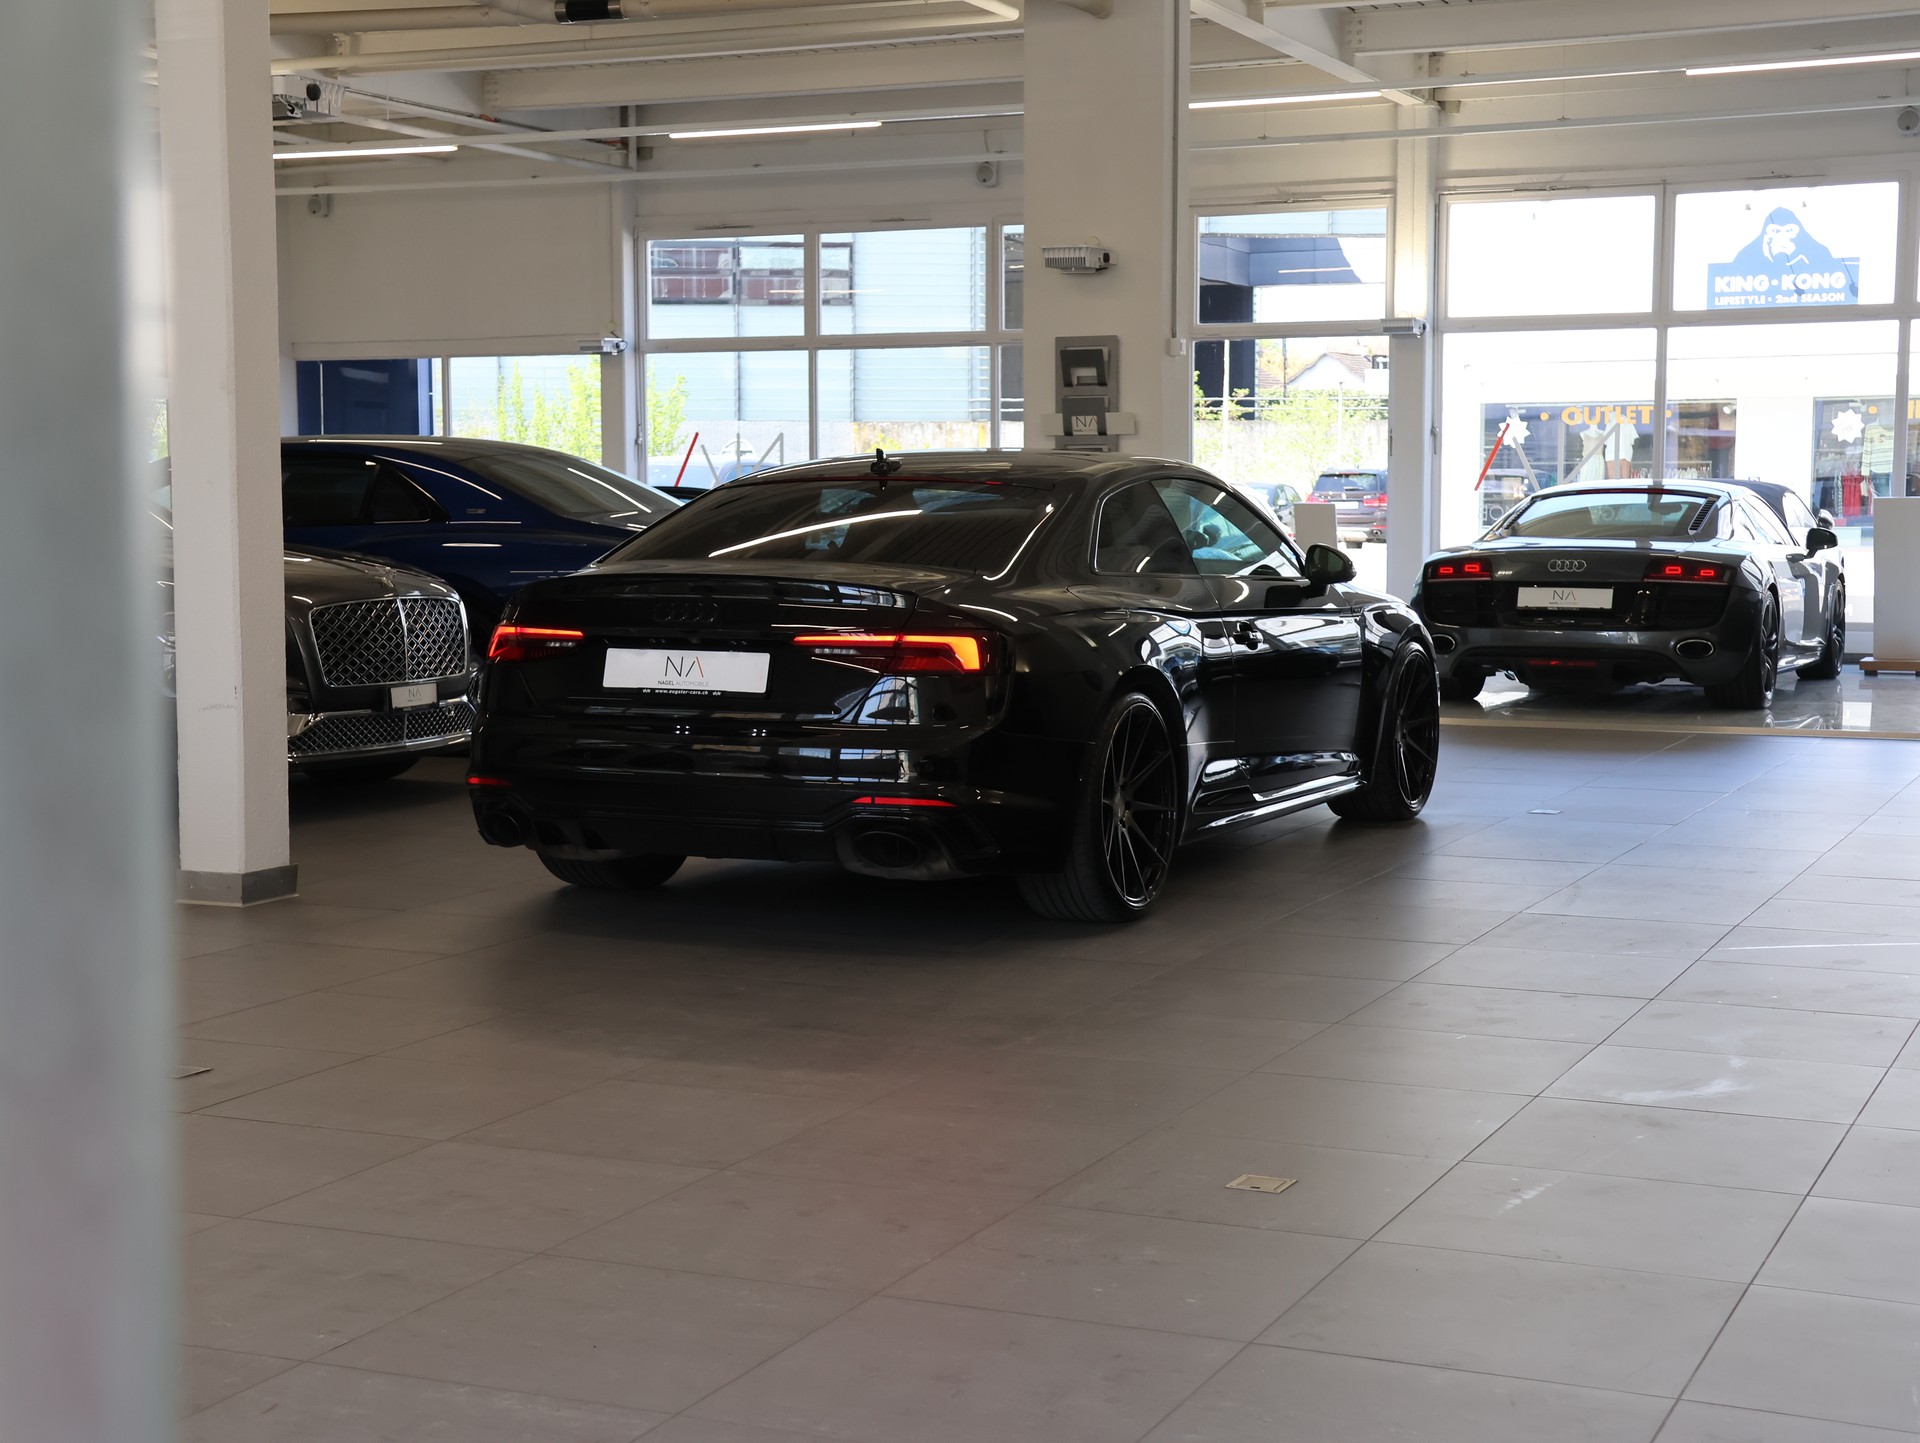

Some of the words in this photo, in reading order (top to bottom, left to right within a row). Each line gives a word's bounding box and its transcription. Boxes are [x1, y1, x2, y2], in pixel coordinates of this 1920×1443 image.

[1714, 275, 1770, 293] KING
[1781, 271, 1847, 290] KONG
[1775, 294, 1798, 304] 2nd
[1801, 292, 1845, 303] SEASON
[1561, 405, 1655, 426] OUTLET
[664, 655, 704, 678] NA
